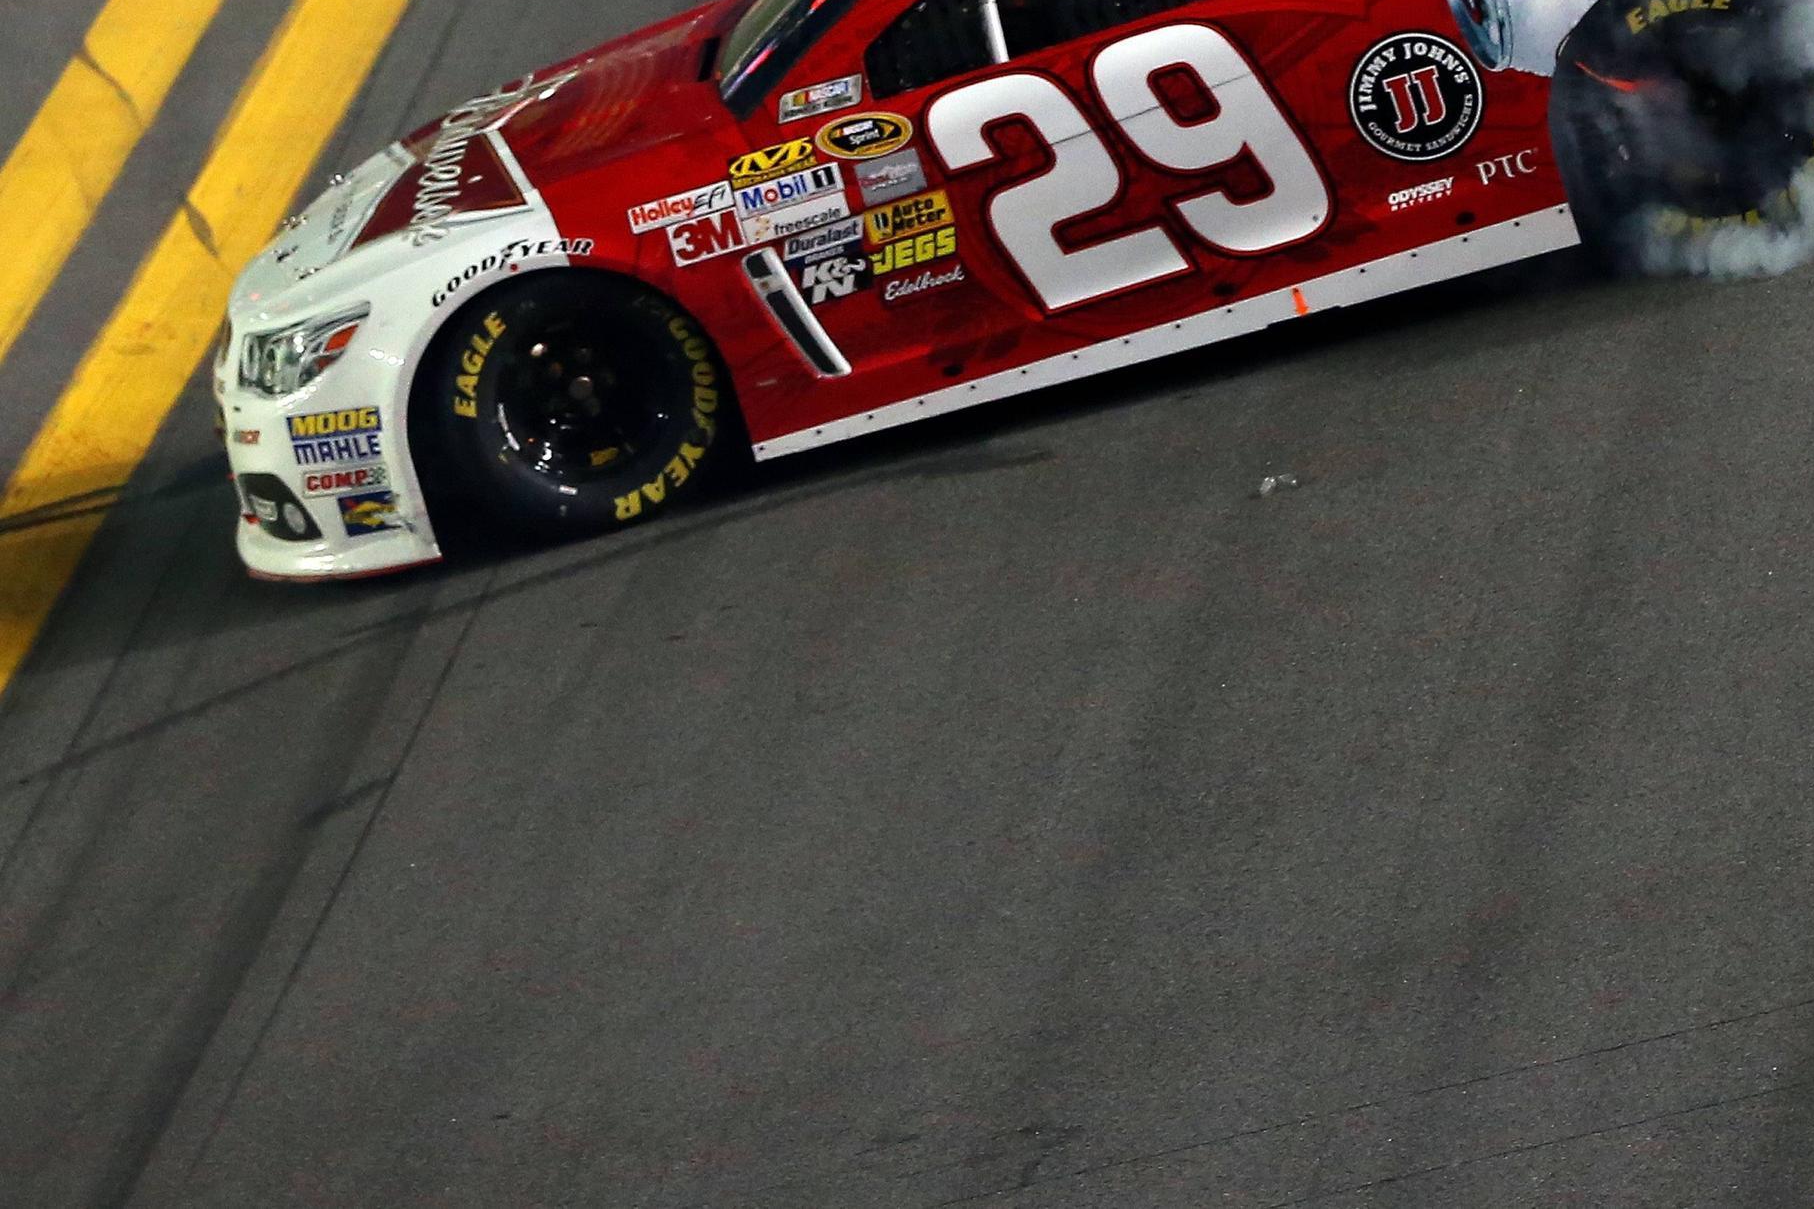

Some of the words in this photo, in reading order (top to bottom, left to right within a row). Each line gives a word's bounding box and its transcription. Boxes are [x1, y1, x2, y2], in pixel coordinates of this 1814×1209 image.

[1359, 47, 1397, 113] JIMMY
[1402, 42, 1470, 84] JOHN'S
[1382, 65, 1446, 134] JJ
[1368, 120, 1422, 152] GOURMET
[1426, 93, 1473, 151] SANDWICHES
[926, 23, 1330, 310] 29
[1475, 149, 1537, 185] PTC
[742, 174, 808, 210] Mobil
[892, 196, 934, 218] Auto
[1387, 176, 1454, 205] ODYSSEY
[1391, 190, 1453, 211] BATTERY
[631, 196, 696, 226] Holley
[773, 207, 841, 236] freescale
[892, 208, 945, 232] Meter
[673, 210, 744, 260] 3M
[788, 220, 859, 255] Duralast
[869, 226, 957, 276] JEGS
[431, 239, 594, 307] GOODYEAR
[884, 264, 966, 301] Edelbrock
[453, 310, 507, 418] EAGLE
[291, 407, 379, 437] MOOG
[613, 317, 718, 522] GOODYEAR
[293, 434, 382, 465] MAHLE
[306, 469, 368, 492] COMP
